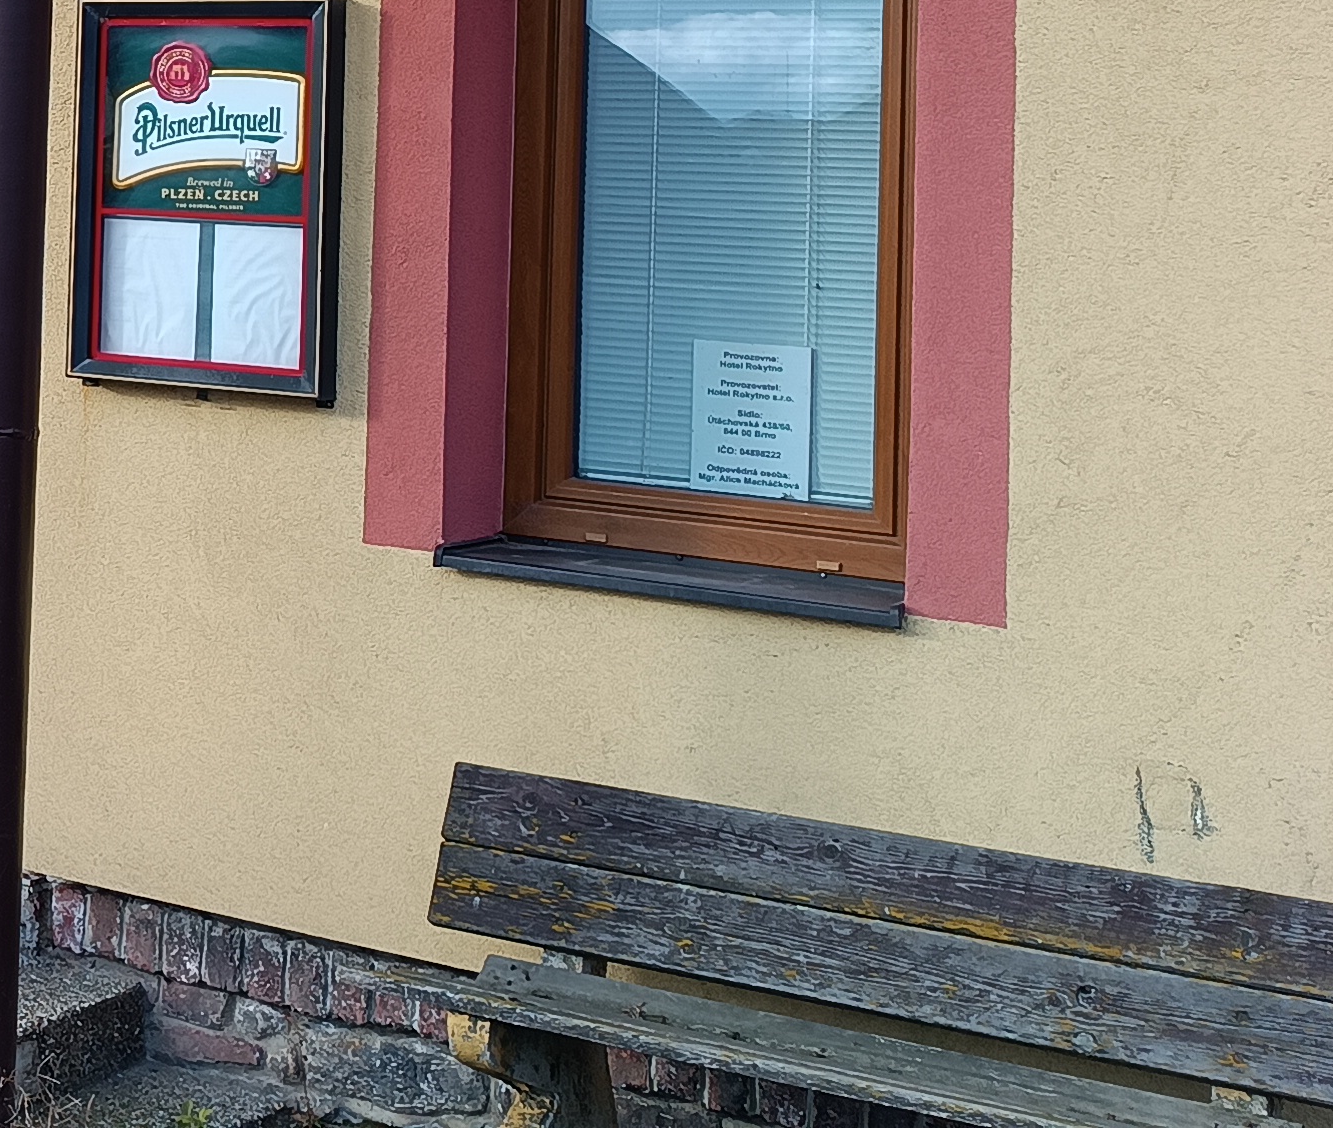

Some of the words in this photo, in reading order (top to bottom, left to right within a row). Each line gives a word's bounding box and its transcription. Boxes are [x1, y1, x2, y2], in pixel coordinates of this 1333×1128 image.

[133, 102, 209, 156] Pilsner
[207, 102, 281, 144] Urquell
[187, 176, 222, 187] Brewed
[223, 178, 234, 188] in
[214, 189, 259, 201] CZECH
[719, 360, 744, 370] Hotel
[745, 362, 783, 373] Rokytno
[707, 388, 731, 398] Hotel
[732, 390, 770, 401] Rokytno
